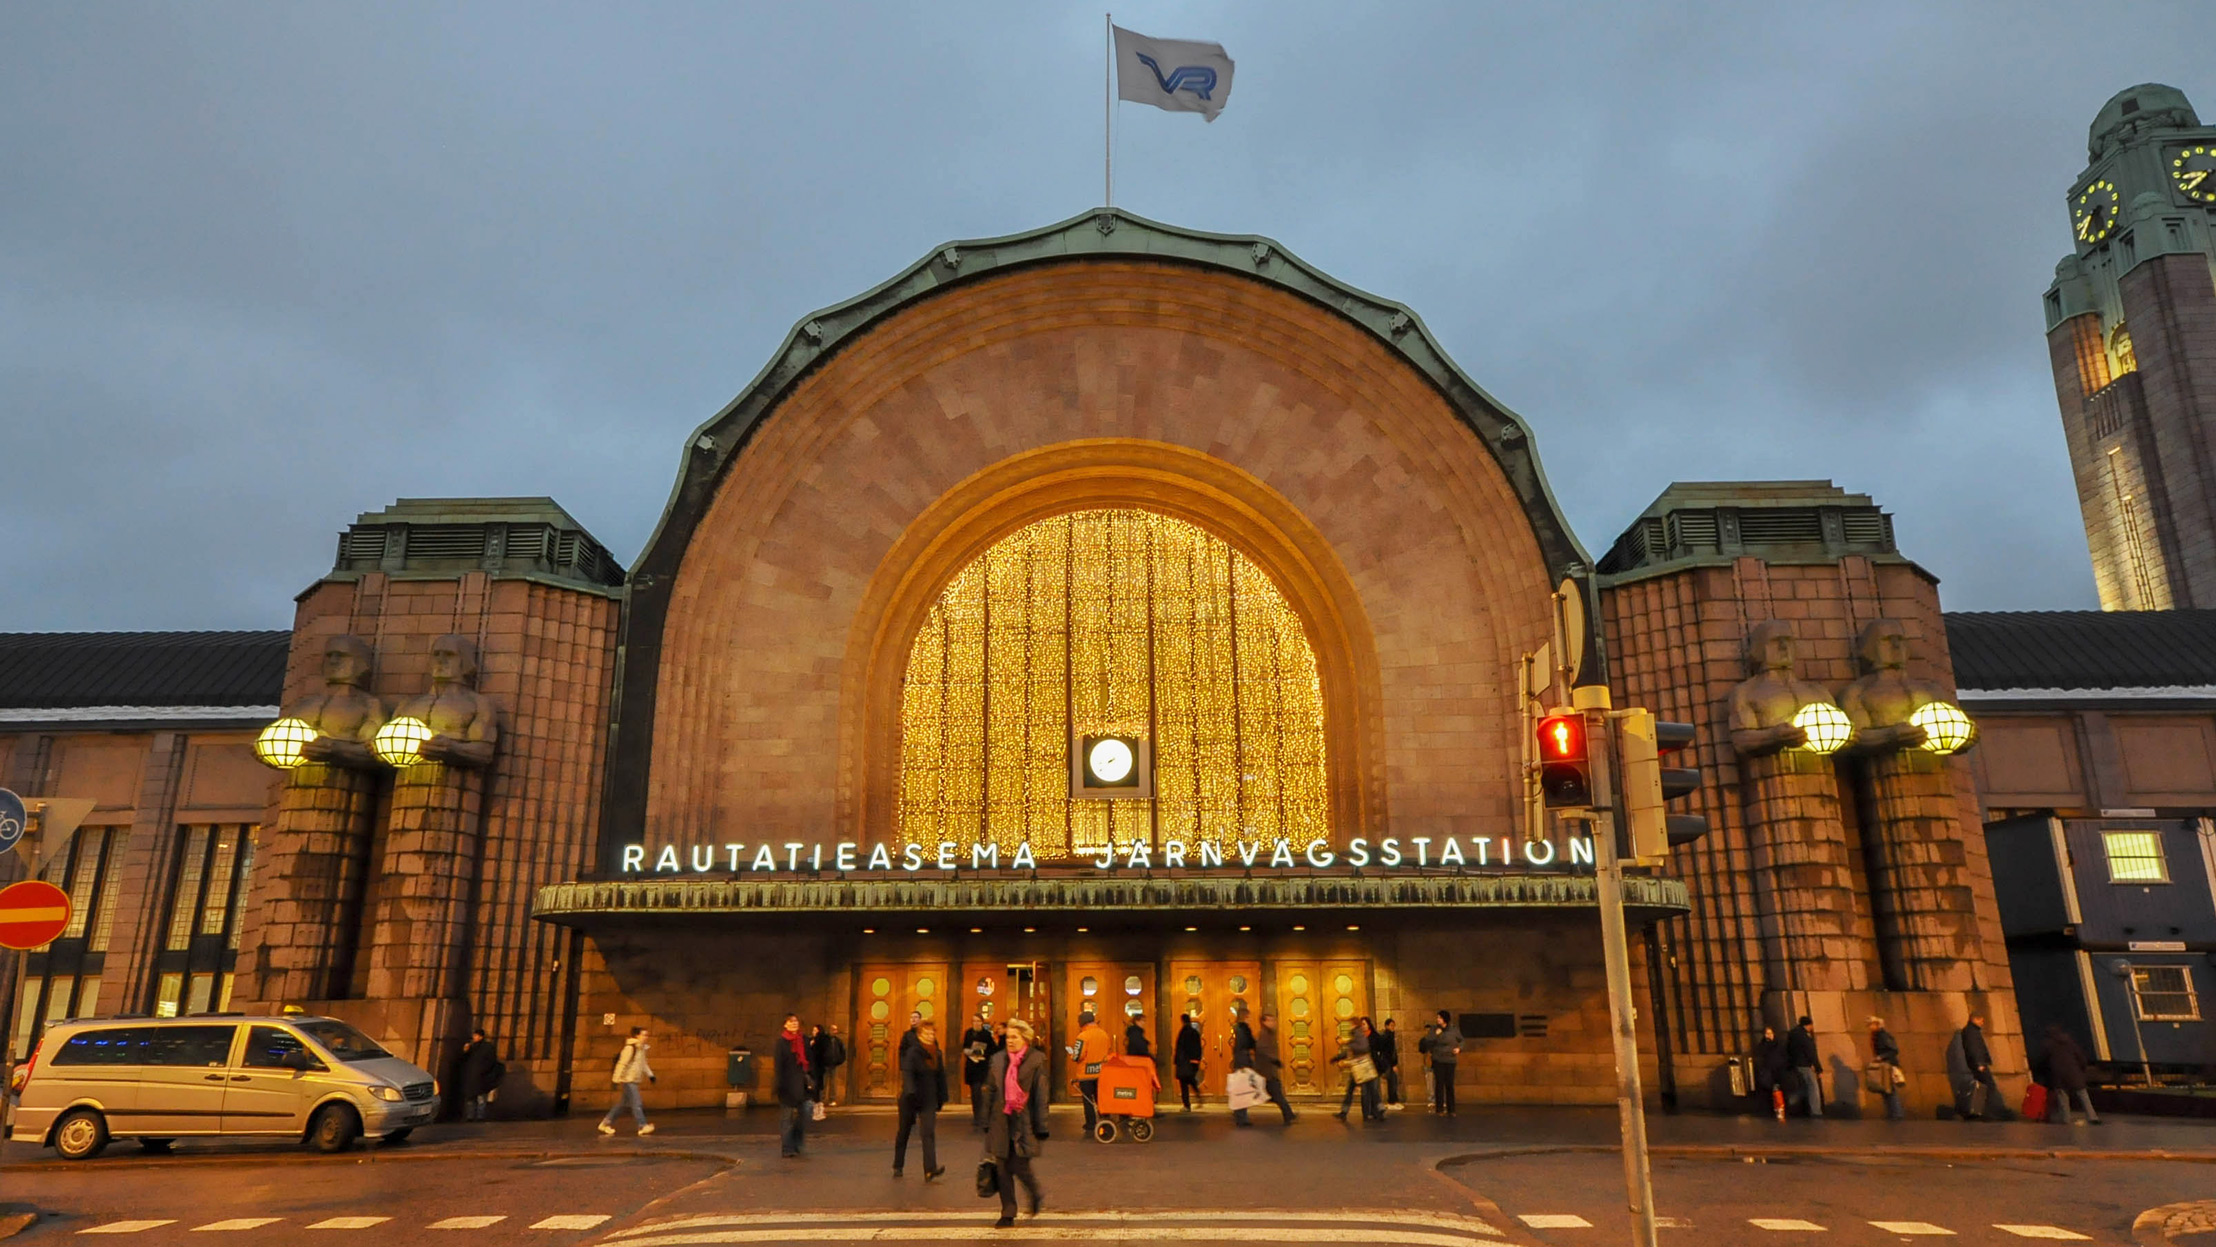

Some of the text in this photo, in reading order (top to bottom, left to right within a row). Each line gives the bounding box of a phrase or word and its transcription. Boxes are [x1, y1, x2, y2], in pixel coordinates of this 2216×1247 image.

[1136, 51, 1217, 101] VR
[622, 842, 1036, 872] RAUTATIEASEMA
[1094, 836, 1594, 869] JÄRNVÄGSSTATION
